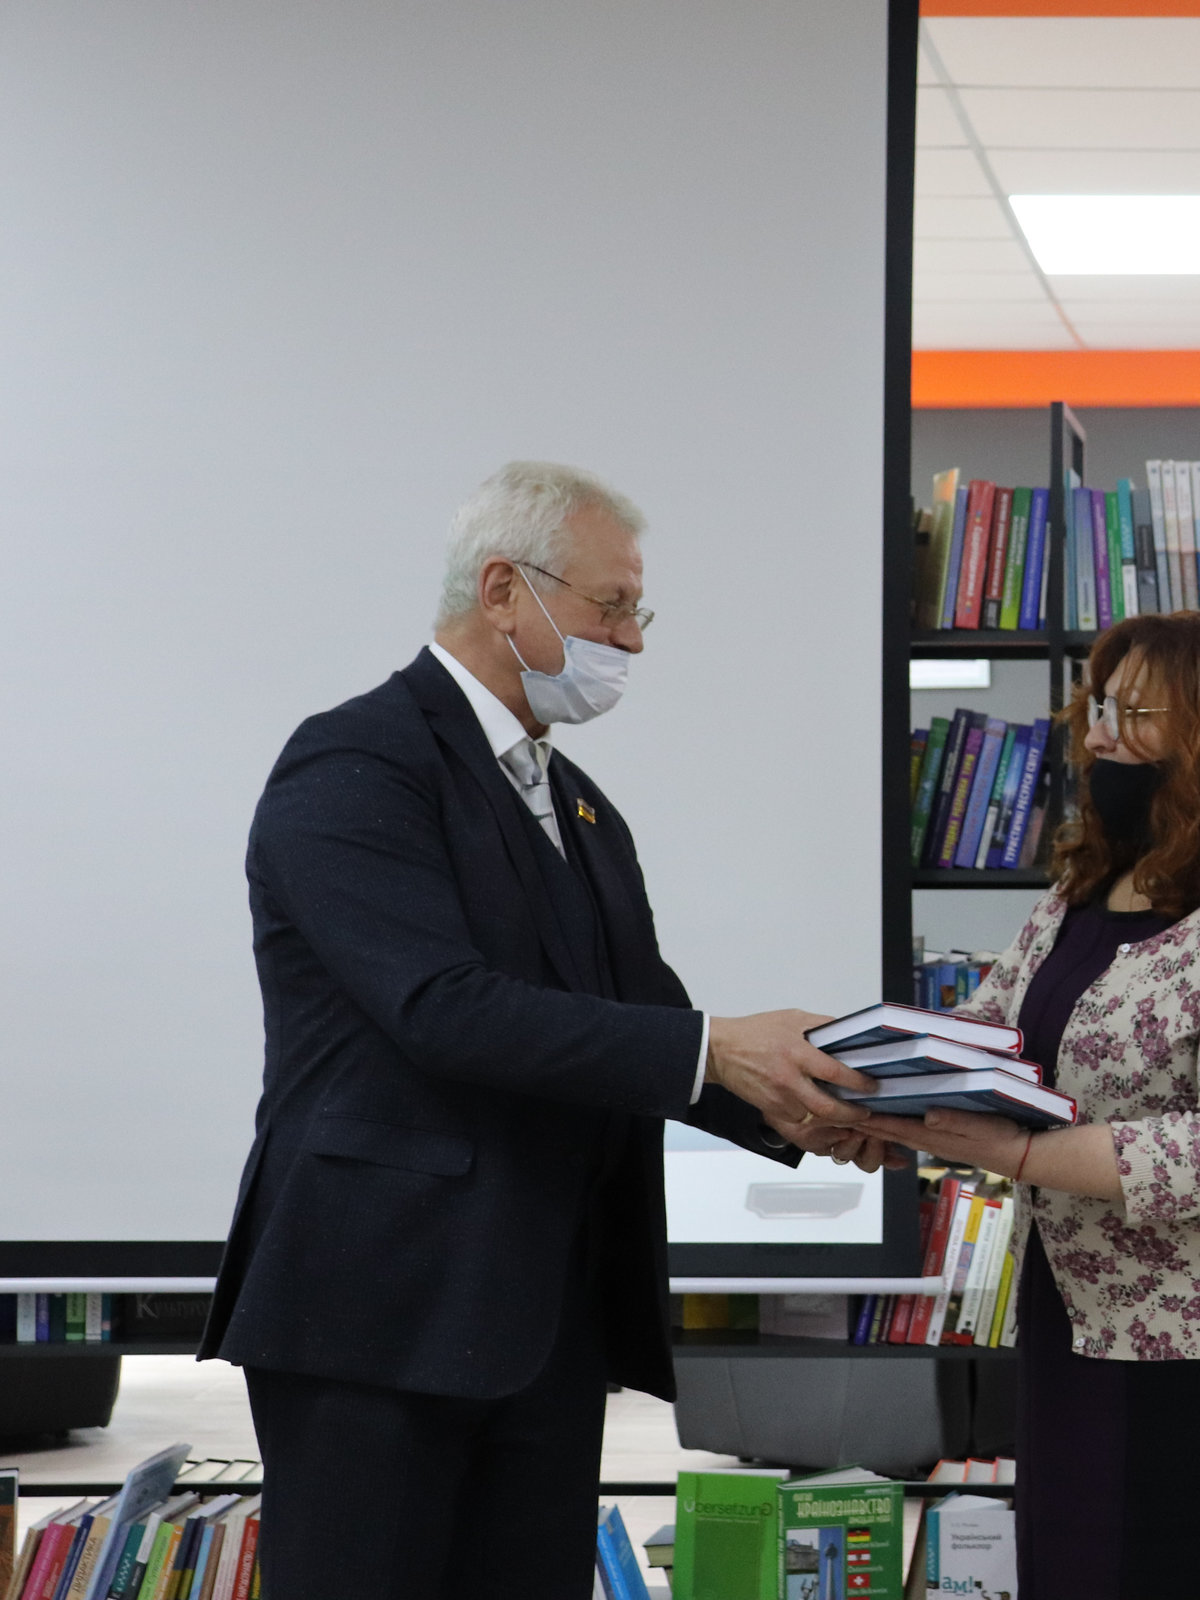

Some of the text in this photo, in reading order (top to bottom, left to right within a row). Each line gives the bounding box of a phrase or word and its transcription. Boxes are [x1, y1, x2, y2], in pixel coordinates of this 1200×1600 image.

[1005, 748, 1039, 862] ТУРИСТИЧНІ РЕСУРСИ СВІТУ
[72, 1536, 98, 1592] ДИДАКТИКА
[942, 1575, 974, 1594] ам!
